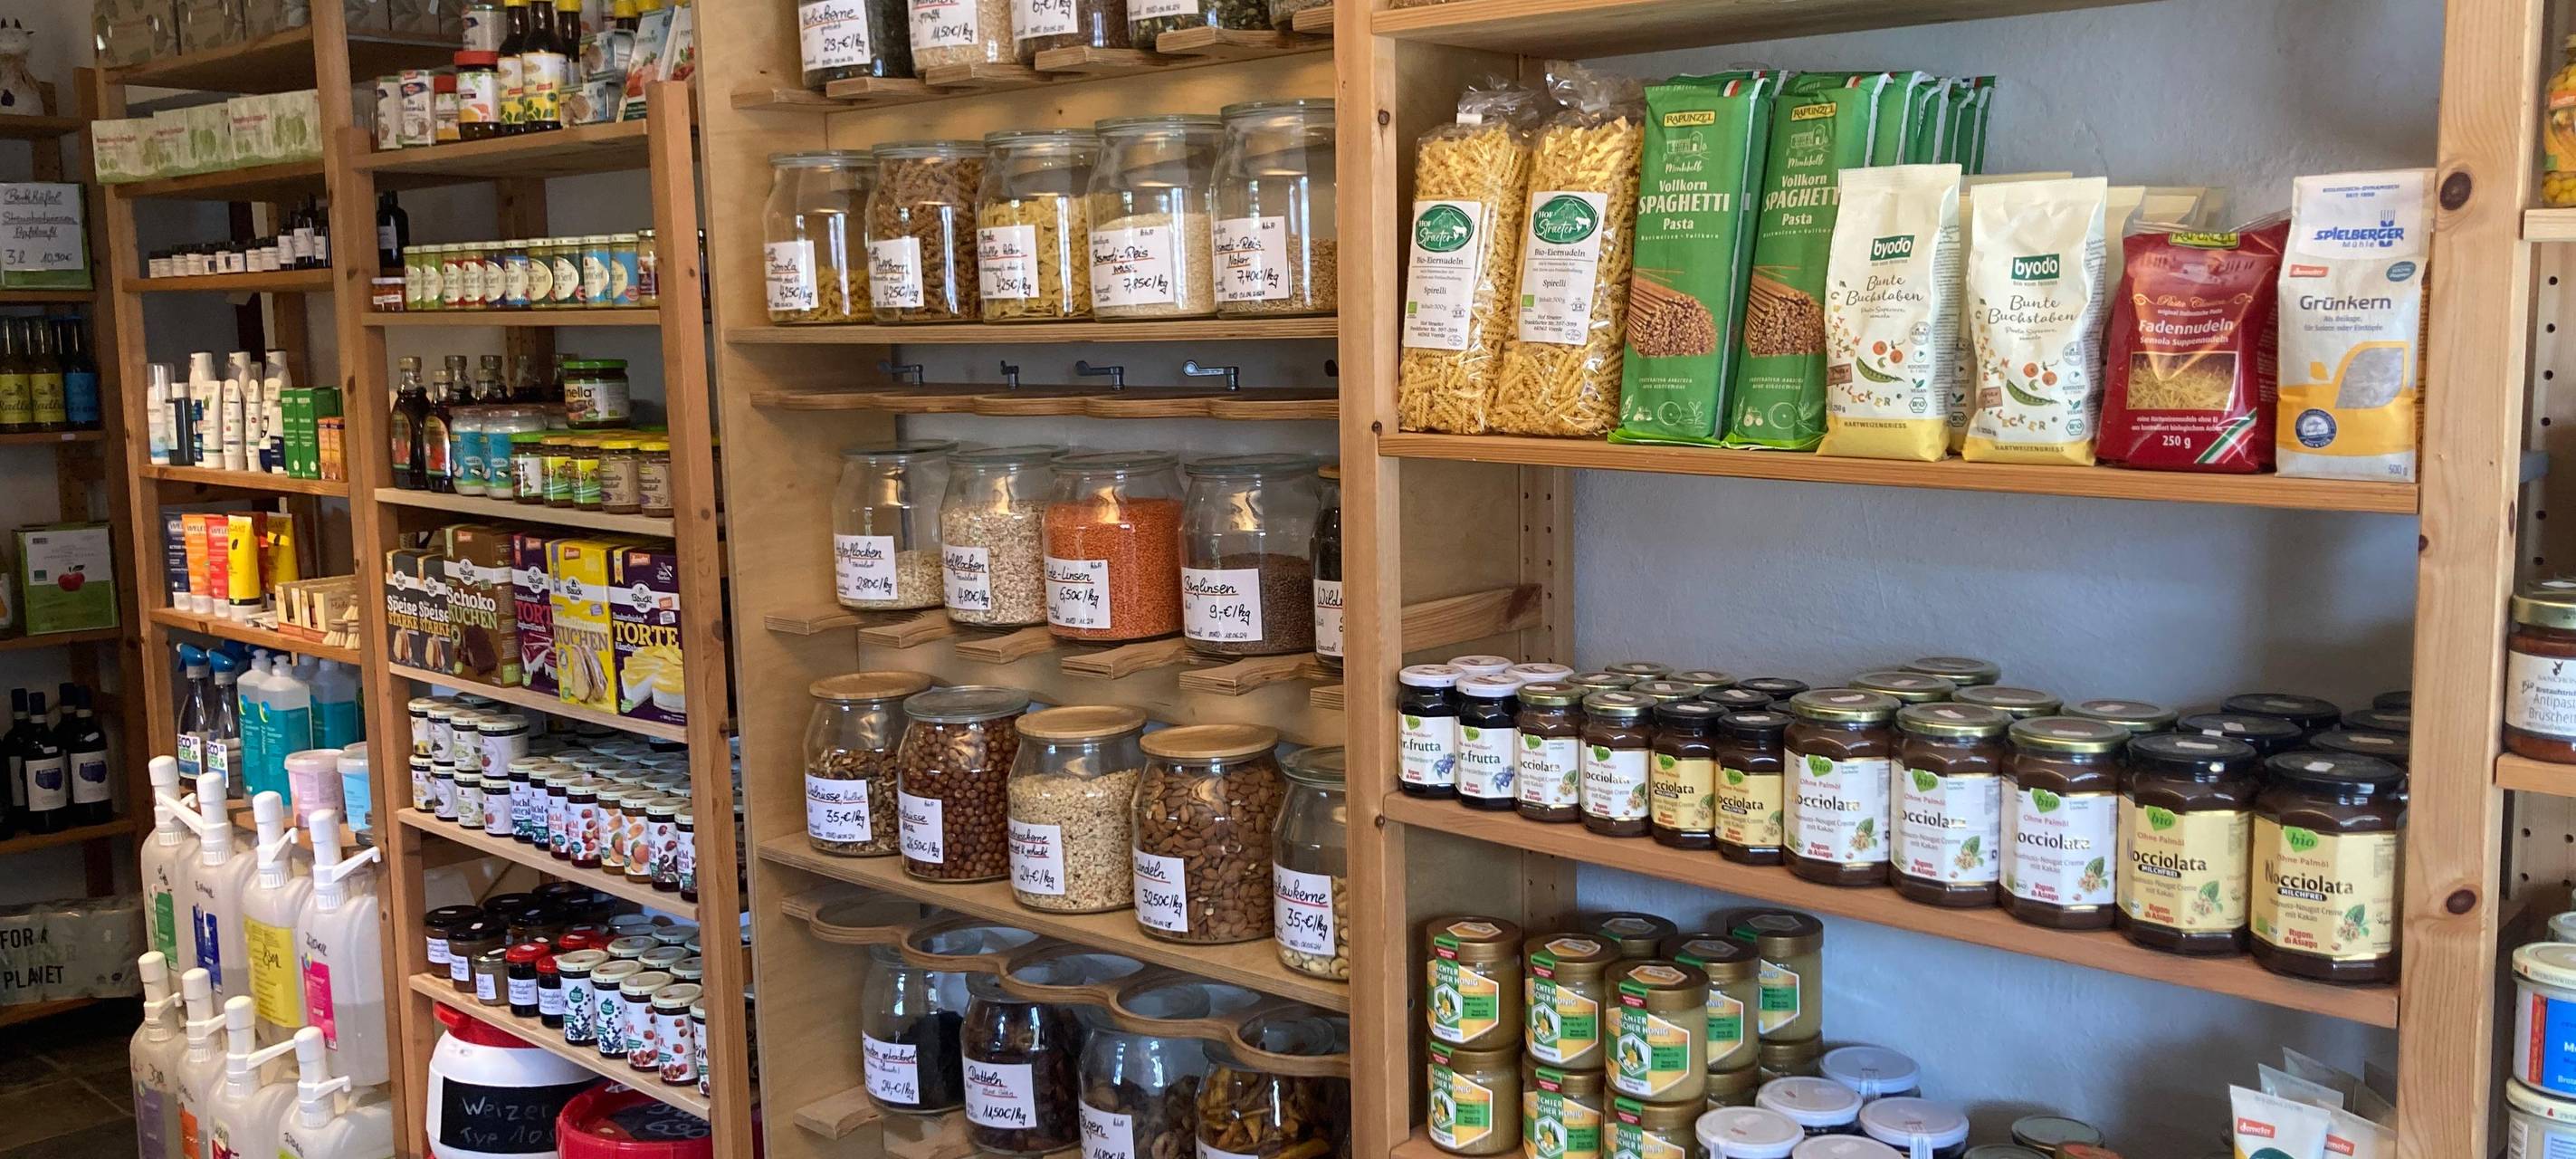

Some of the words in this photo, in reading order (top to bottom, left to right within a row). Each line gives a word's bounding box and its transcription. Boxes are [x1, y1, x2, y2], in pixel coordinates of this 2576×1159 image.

[1665, 113, 1714, 125] RAPUNZEL
[1793, 104, 1835, 119] RAPUNZEL
[1658, 179, 1708, 193] Vollkorn
[1781, 174, 1827, 188] Vollkorn
[1638, 193, 1731, 216] SPAGHETTI
[1764, 187, 1839, 213] SPAGHETT
[1663, 217, 1694, 231] Pasta
[1781, 213, 1813, 226] Pasta
[2312, 225, 2405, 242] SPIELBERGER
[1534, 248, 1586, 258] Bio-Eiernudeln
[1873, 237, 1912, 259] byodo
[1417, 256, 1464, 265] Bio-Eiernudeln
[2014, 258, 2058, 279] byodo
[1423, 285, 1447, 296] Spirelli
[1541, 278, 1567, 289] Spirelli
[1866, 274, 1906, 292] Bunte
[1846, 290, 1923, 306] Buchstaben
[2009, 294, 2062, 311] Bunte
[2299, 294, 2392, 311] Grünkern
[1987, 308, 2077, 325] Buchstaben
[2138, 318, 2234, 335] Fadennudeln
[2140, 336, 2171, 345] Semola
[2172, 335, 2229, 348] Suppennudeln
[2162, 435, 2182, 446] 250
[2184, 436, 2191, 449] g
[446, 586, 497, 612] Schoko
[1316, 588, 1344, 607] Wild
[386, 594, 418, 617] Speise
[418, 599, 449, 623] Speise
[514, 599, 552, 627] TORT
[612, 620, 679, 647] TORTE
[2533, 693, 2576, 711] Antipast
[1520, 759, 1560, 772] occiolata
[1810, 760, 1831, 772] bio
[1652, 781, 1694, 794] occiolata
[1915, 775, 1936, 788] bio
[1718, 795, 1764, 810] occiolata
[2037, 795, 2057, 809] bio
[2023, 814, 2043, 825] Ohne
[2044, 817, 2070, 828] Palmöl
[2151, 813, 2173, 827] bio
[2018, 831, 2091, 850] occiolata
[2137, 831, 2157, 841] Ohne
[2158, 835, 2185, 847] Palmöl
[2290, 831, 2315, 848] bio
[2127, 838, 2207, 872] Nocciolata
[2276, 854, 2298, 865] Ohne
[2300, 857, 2329, 867] Palmöl
[2141, 864, 2179, 878] MILCHFREI
[2265, 860, 2354, 896] Nocciolata
[2280, 887, 2323, 902] MILCHFREI
[0, 928, 33, 950] FOR
[2288, 928, 2314, 940] Rigoni
[2284, 936, 2292, 944] di
[2292, 938, 2318, 949] Asiago
[4, 965, 64, 990] PLANET
[2239, 1121, 2271, 1137] demeter
[2325, 1141, 2351, 1154] meter
